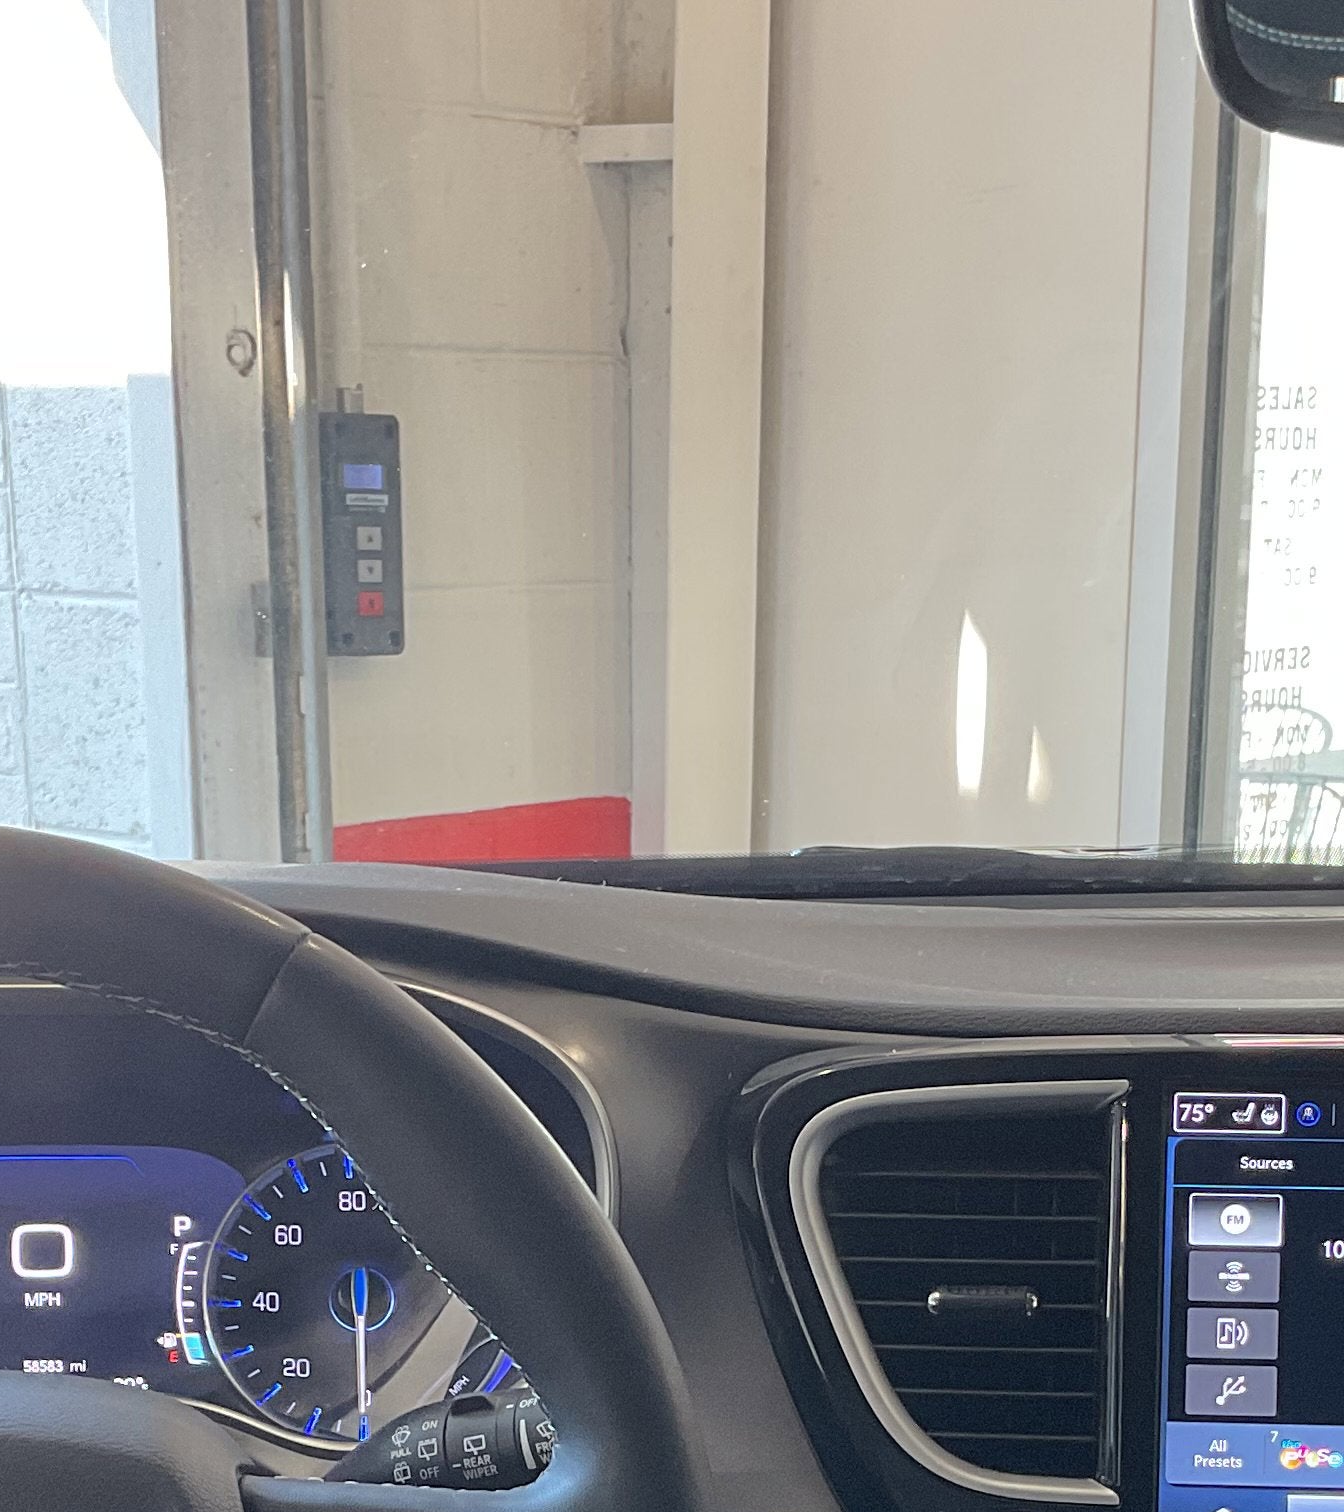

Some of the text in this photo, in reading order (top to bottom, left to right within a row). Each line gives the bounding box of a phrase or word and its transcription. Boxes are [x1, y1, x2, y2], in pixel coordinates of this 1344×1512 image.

[1178, 1103, 1215, 1123] 75°
[1239, 1155, 1294, 1171] Sources
[338, 1190, 367, 1212] 80
[172, 1215, 193, 1238] P
[1226, 1214, 1245, 1225] FM
[274, 1224, 303, 1247] 60
[169, 1243, 179, 1256] F
[23, 1292, 62, 1308] MPH
[252, 1291, 280, 1313] 40
[168, 1350, 179, 1364] E
[22, 1359, 87, 1373] 58583 mi
[282, 1358, 311, 1378] 20
[448, 1375, 471, 1397] MPH
[421, 1420, 439, 1431] ON
[1269, 1430, 1280, 1443] 7
[1208, 1439, 1227, 1453] All
[462, 1454, 492, 1469] REAR
[1193, 1454, 1243, 1471] Presets
[419, 1466, 440, 1481] OFF
[462, 1464, 499, 1481] WIPER
